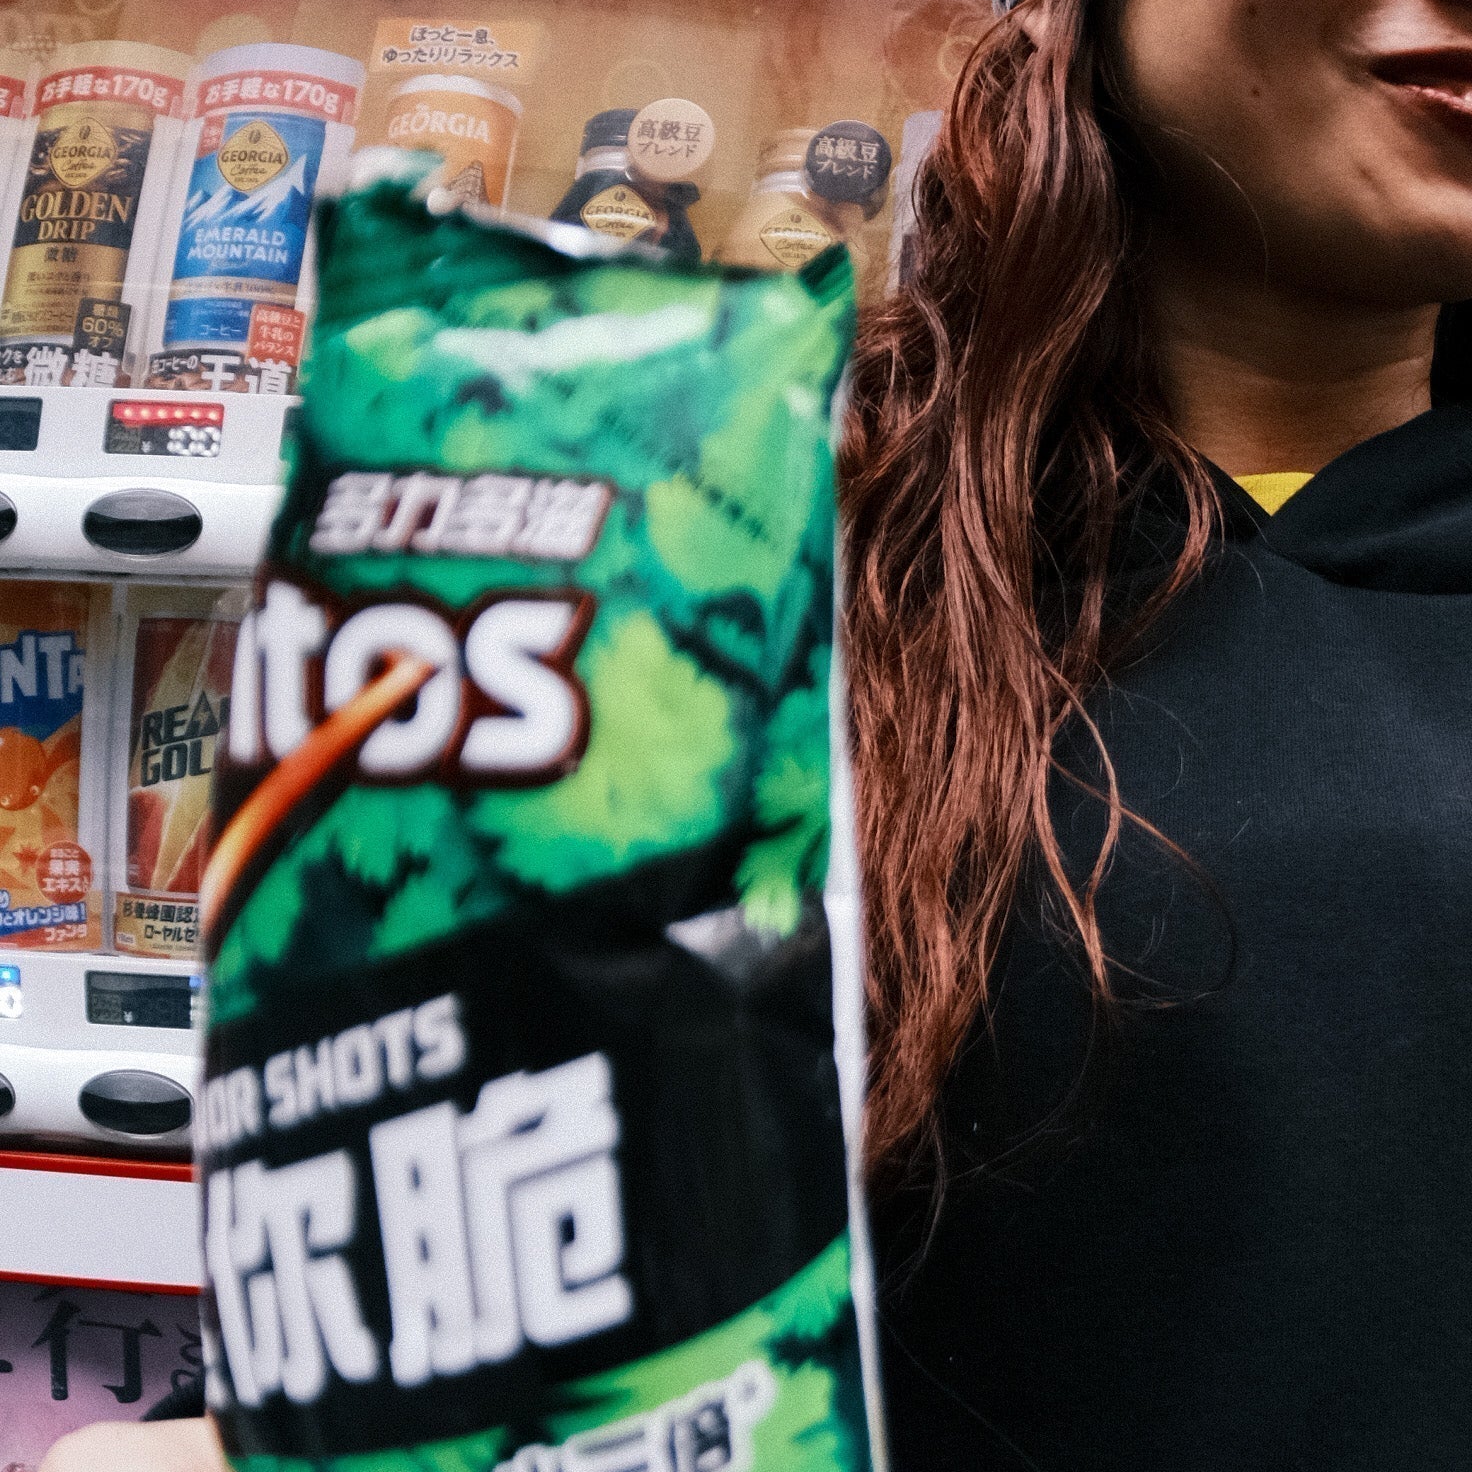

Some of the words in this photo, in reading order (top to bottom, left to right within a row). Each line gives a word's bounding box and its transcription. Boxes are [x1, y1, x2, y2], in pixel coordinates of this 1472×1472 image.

[410, 25, 496, 47] ほっと一息、
[382, 46, 520, 69] ゆったりリラックス
[41, 73, 169, 108] お手軽な170g
[204, 77, 341, 115] お手軽な170g
[637, 118, 706, 144] 高級豆
[53, 145, 113, 161] GEORGIA
[220, 146, 285, 166] GEORGIA
[637, 140, 699, 160] ブレンド
[814, 135, 881, 164] 高級豆
[816, 159, 876, 180] ブレンド
[21, 189, 133, 224] GOLDEN
[37, 217, 97, 242] DRIP
[193, 226, 287, 248] EMERALD
[186, 242, 290, 265] MOUNTAIN
[82, 315, 125, 338] 60%
[25, 344, 120, 387] 微糖
[201, 353, 293, 395] 王道
[44, 923, 88, 943] ファンタ
[144, 924, 200, 944] ローヤルゼ
[196, 1064, 261, 1151] OR
[264, 991, 466, 1129] SHOTS
[205, 1051, 634, 1410] 你脆
